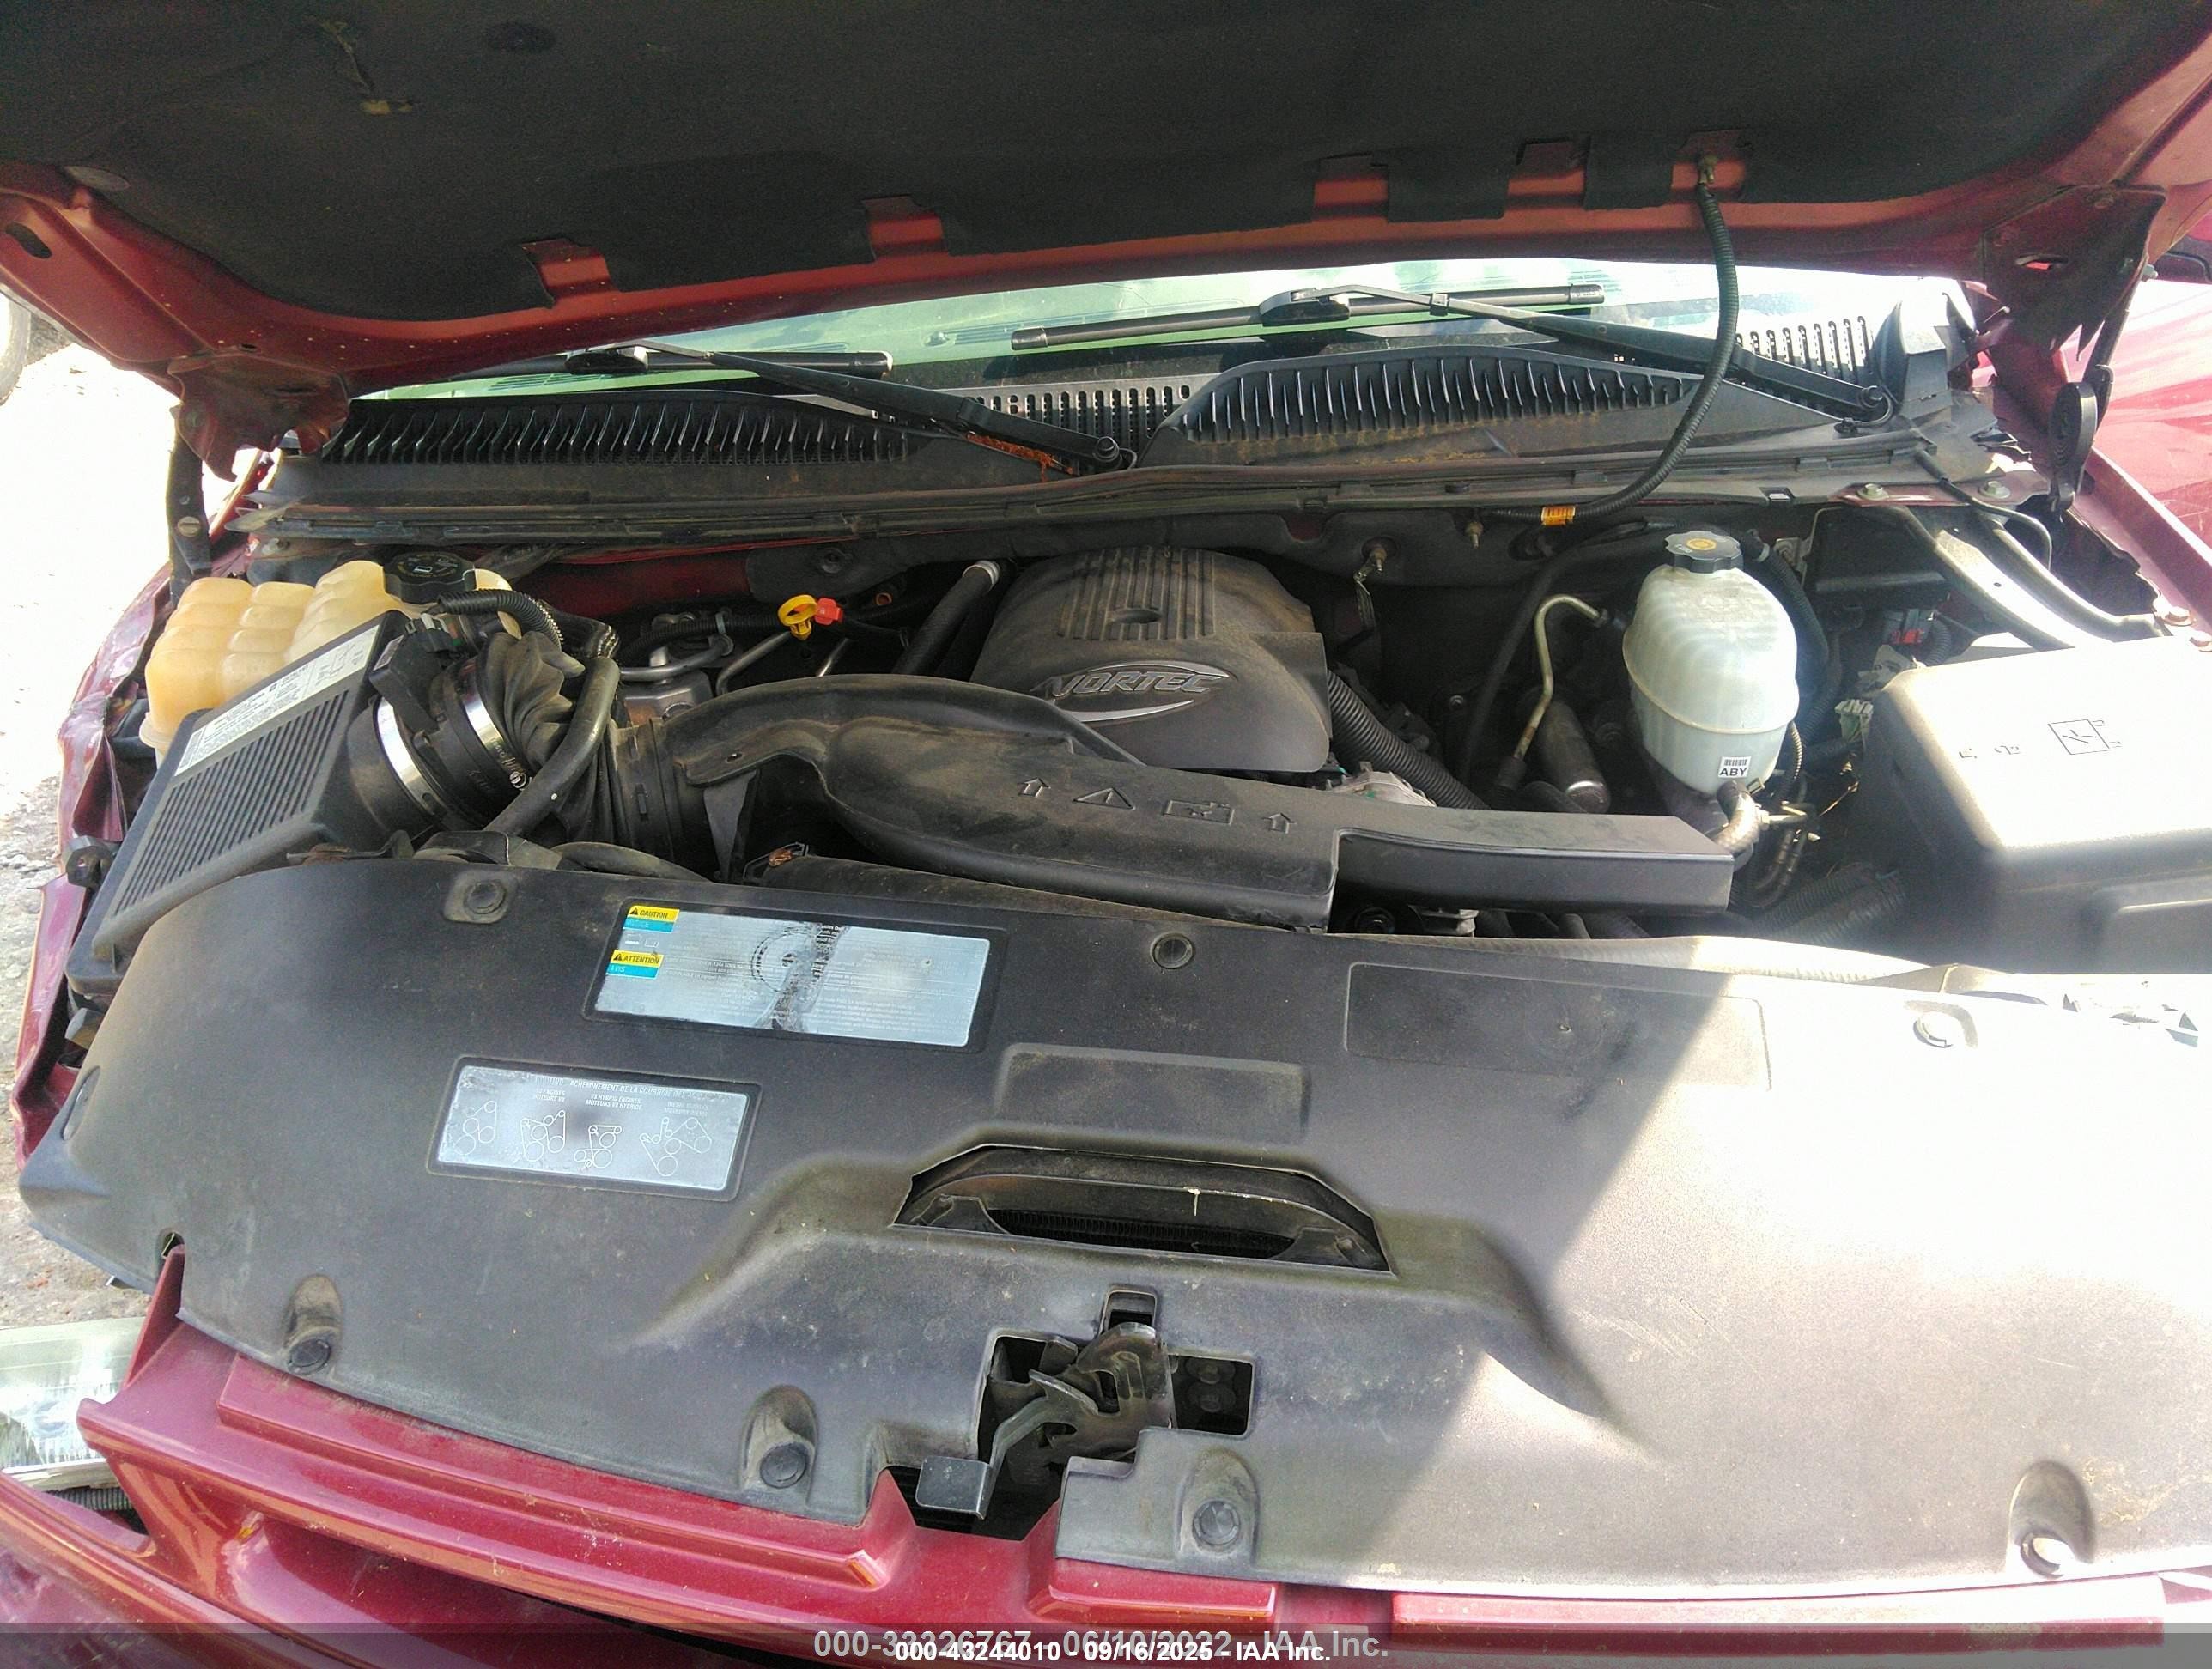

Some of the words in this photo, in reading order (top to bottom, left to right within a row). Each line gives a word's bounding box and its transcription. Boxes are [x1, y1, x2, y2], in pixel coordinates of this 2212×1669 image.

[1045, 671, 1222, 697] VORTEC
[1719, 768, 1747, 776] ABY
[639, 910, 667, 919] CAUTION
[623, 955, 659, 965] ATTENTION
